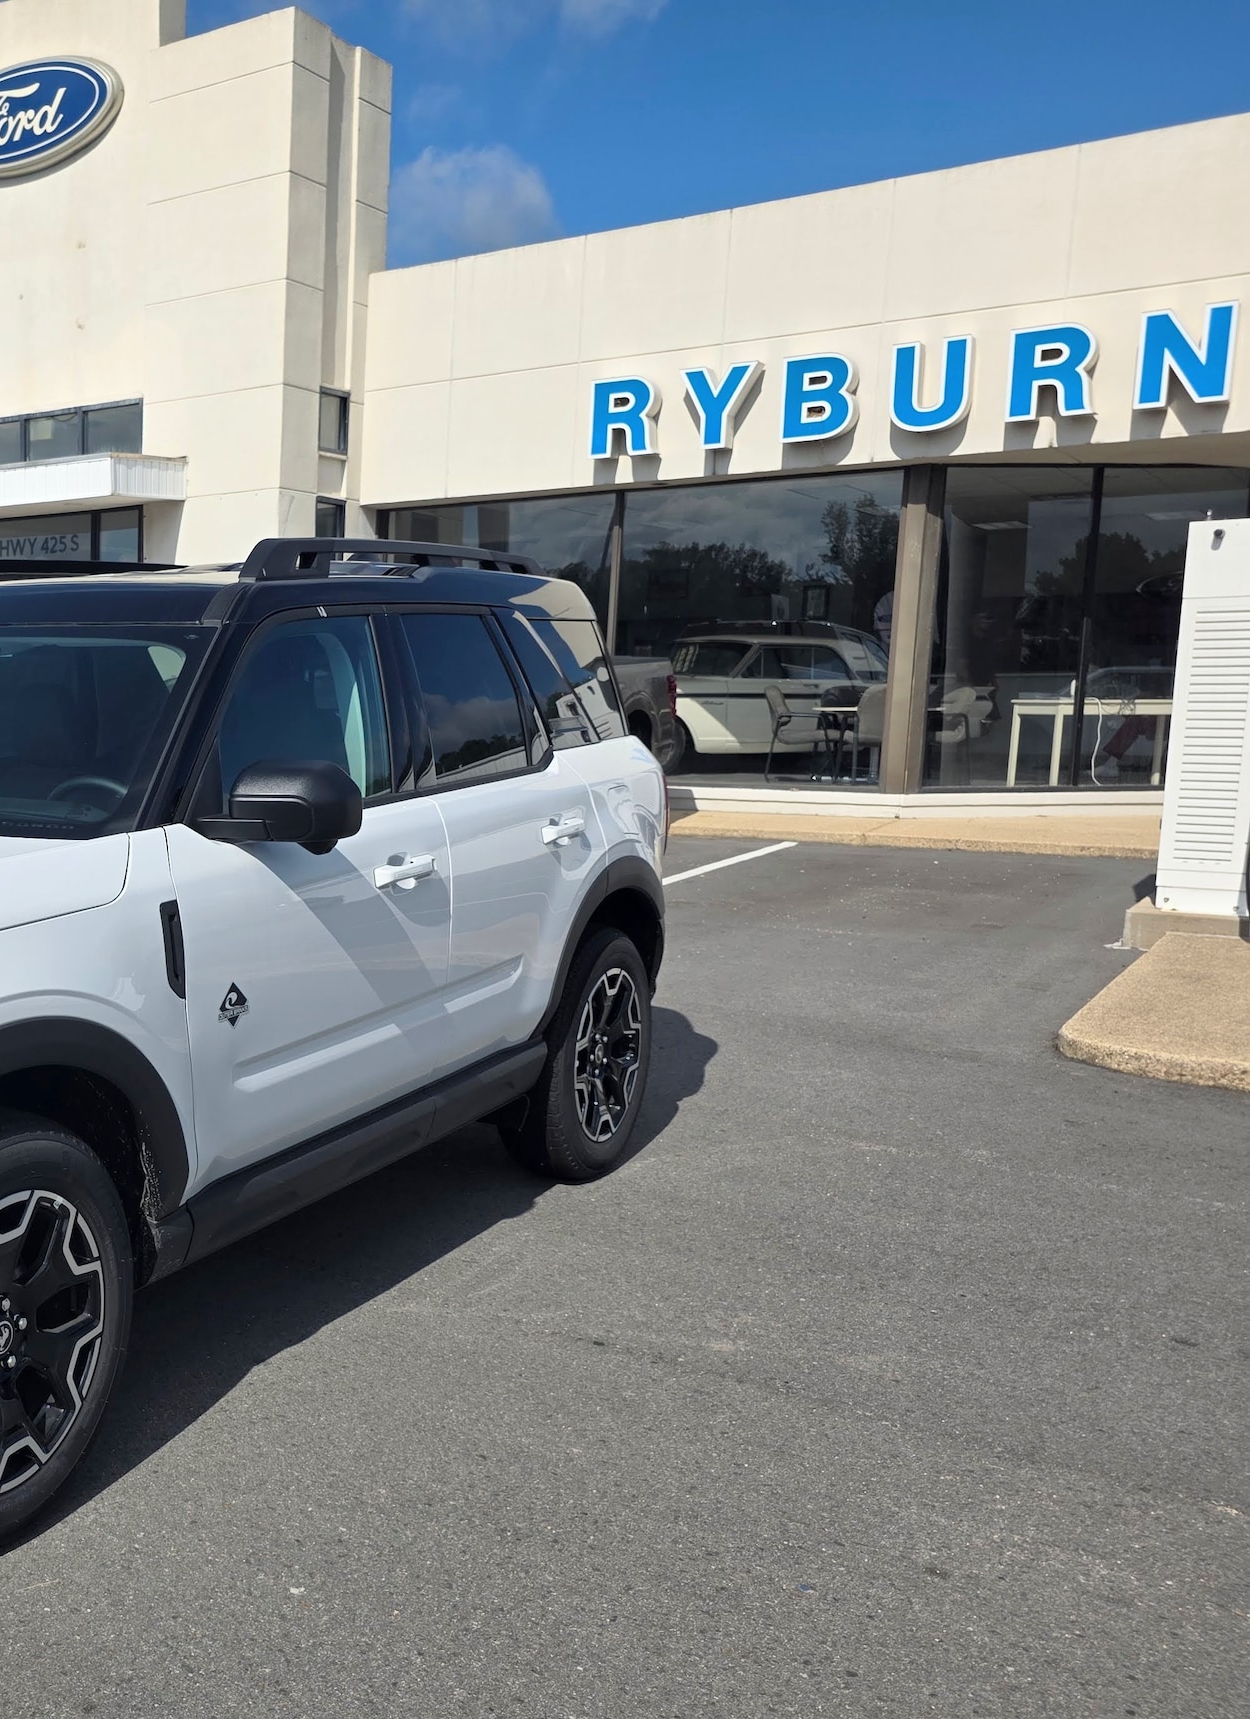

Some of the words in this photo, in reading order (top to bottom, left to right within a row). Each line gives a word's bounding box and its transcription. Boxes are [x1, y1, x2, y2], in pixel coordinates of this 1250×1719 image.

[588, 300, 1240, 460] RYBURN
[0, 537, 38, 557] HWY
[41, 535, 67, 554] 425
[70, 534, 80, 552] S
